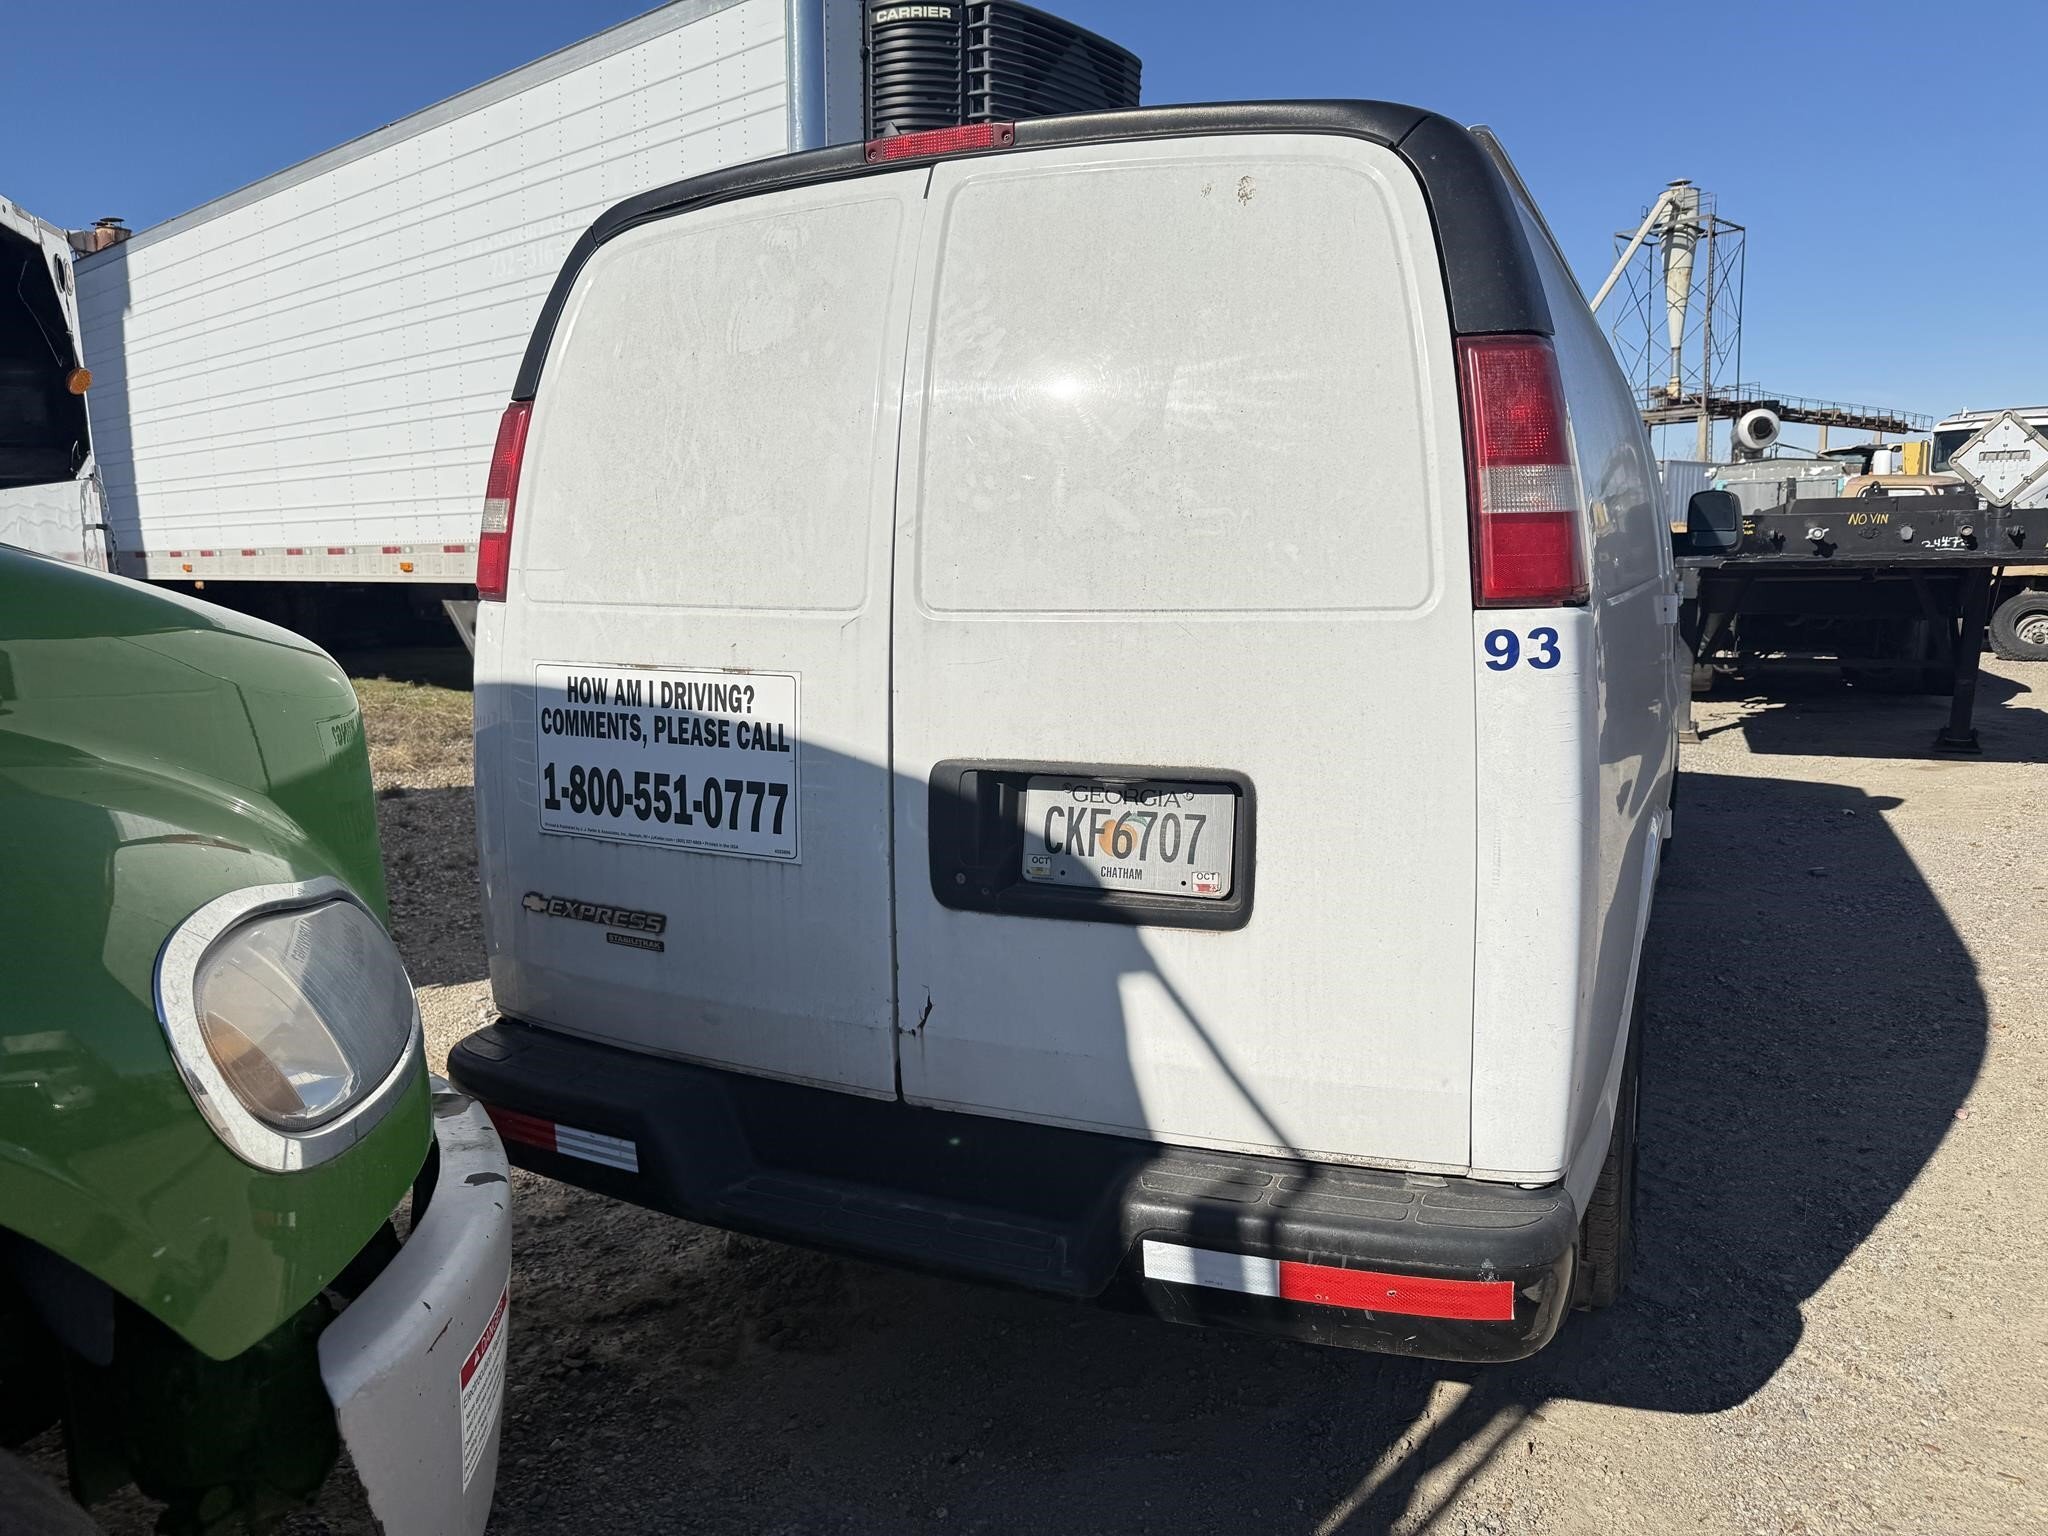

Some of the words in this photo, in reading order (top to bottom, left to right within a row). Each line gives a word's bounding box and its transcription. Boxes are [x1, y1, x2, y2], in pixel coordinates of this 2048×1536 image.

[876, 5, 951, 23] CARRIER
[1848, 513, 1867, 525] NO
[1870, 512, 1889, 524] VIN
[1484, 627, 1561, 671] 93
[567, 676, 608, 705] HOW
[614, 678, 642, 707] AM
[649, 680, 654, 708] I
[661, 681, 755, 714] DRIVING?
[541, 707, 648, 749] COMMENTS,
[654, 715, 730, 748] PLEASE
[737, 721, 790, 752] CALL
[544, 762, 789, 835] 1-800-551-0777
[1072, 784, 1182, 808] GEORGIA
[1044, 805, 1207, 865] CKF6707
[1032, 856, 1050, 864] OCT
[1100, 866, 1143, 880] CHATHAM
[1196, 872, 1216, 881] OCT
[550, 899, 664, 932] EXPRESS
